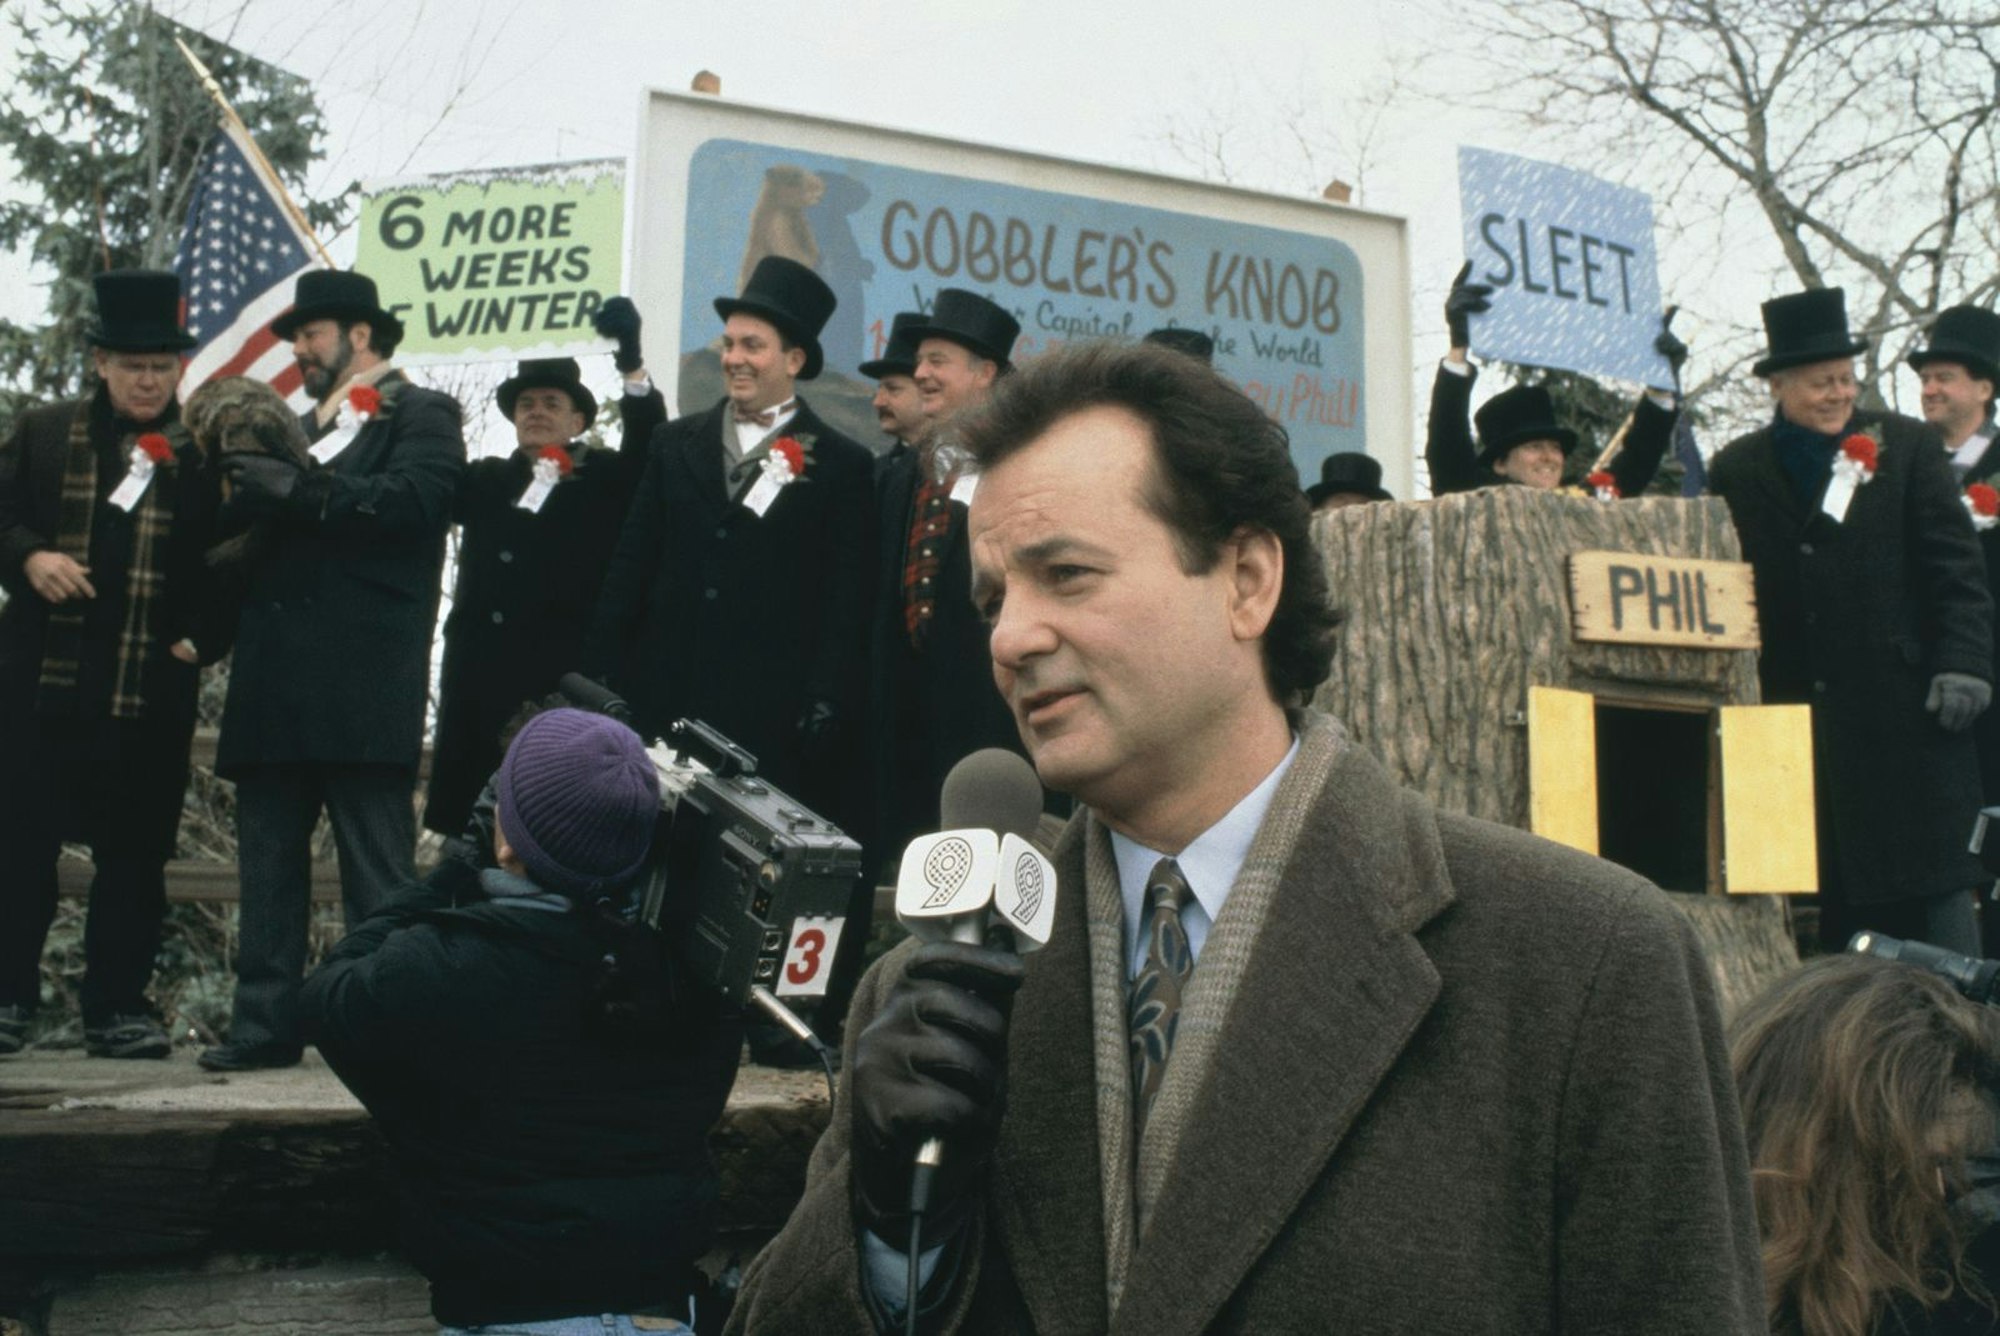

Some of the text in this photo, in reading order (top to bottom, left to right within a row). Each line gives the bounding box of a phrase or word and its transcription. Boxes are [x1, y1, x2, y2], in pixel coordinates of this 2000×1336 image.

[379, 196, 577, 250] 6 MORE
[420, 246, 591, 293] WEEKS
[881, 199, 1340, 334] GOBBLER'S KNOB
[1480, 212, 1635, 314] SLEET
[426, 290, 604, 338] WINTER
[1212, 325, 1236, 355] he
[1251, 330, 1323, 368] World
[1608, 564, 1725, 634] PHIL
[921, 837, 973, 909] 9
[1011, 851, 1044, 926] 9
[787, 928, 826, 985] 3
